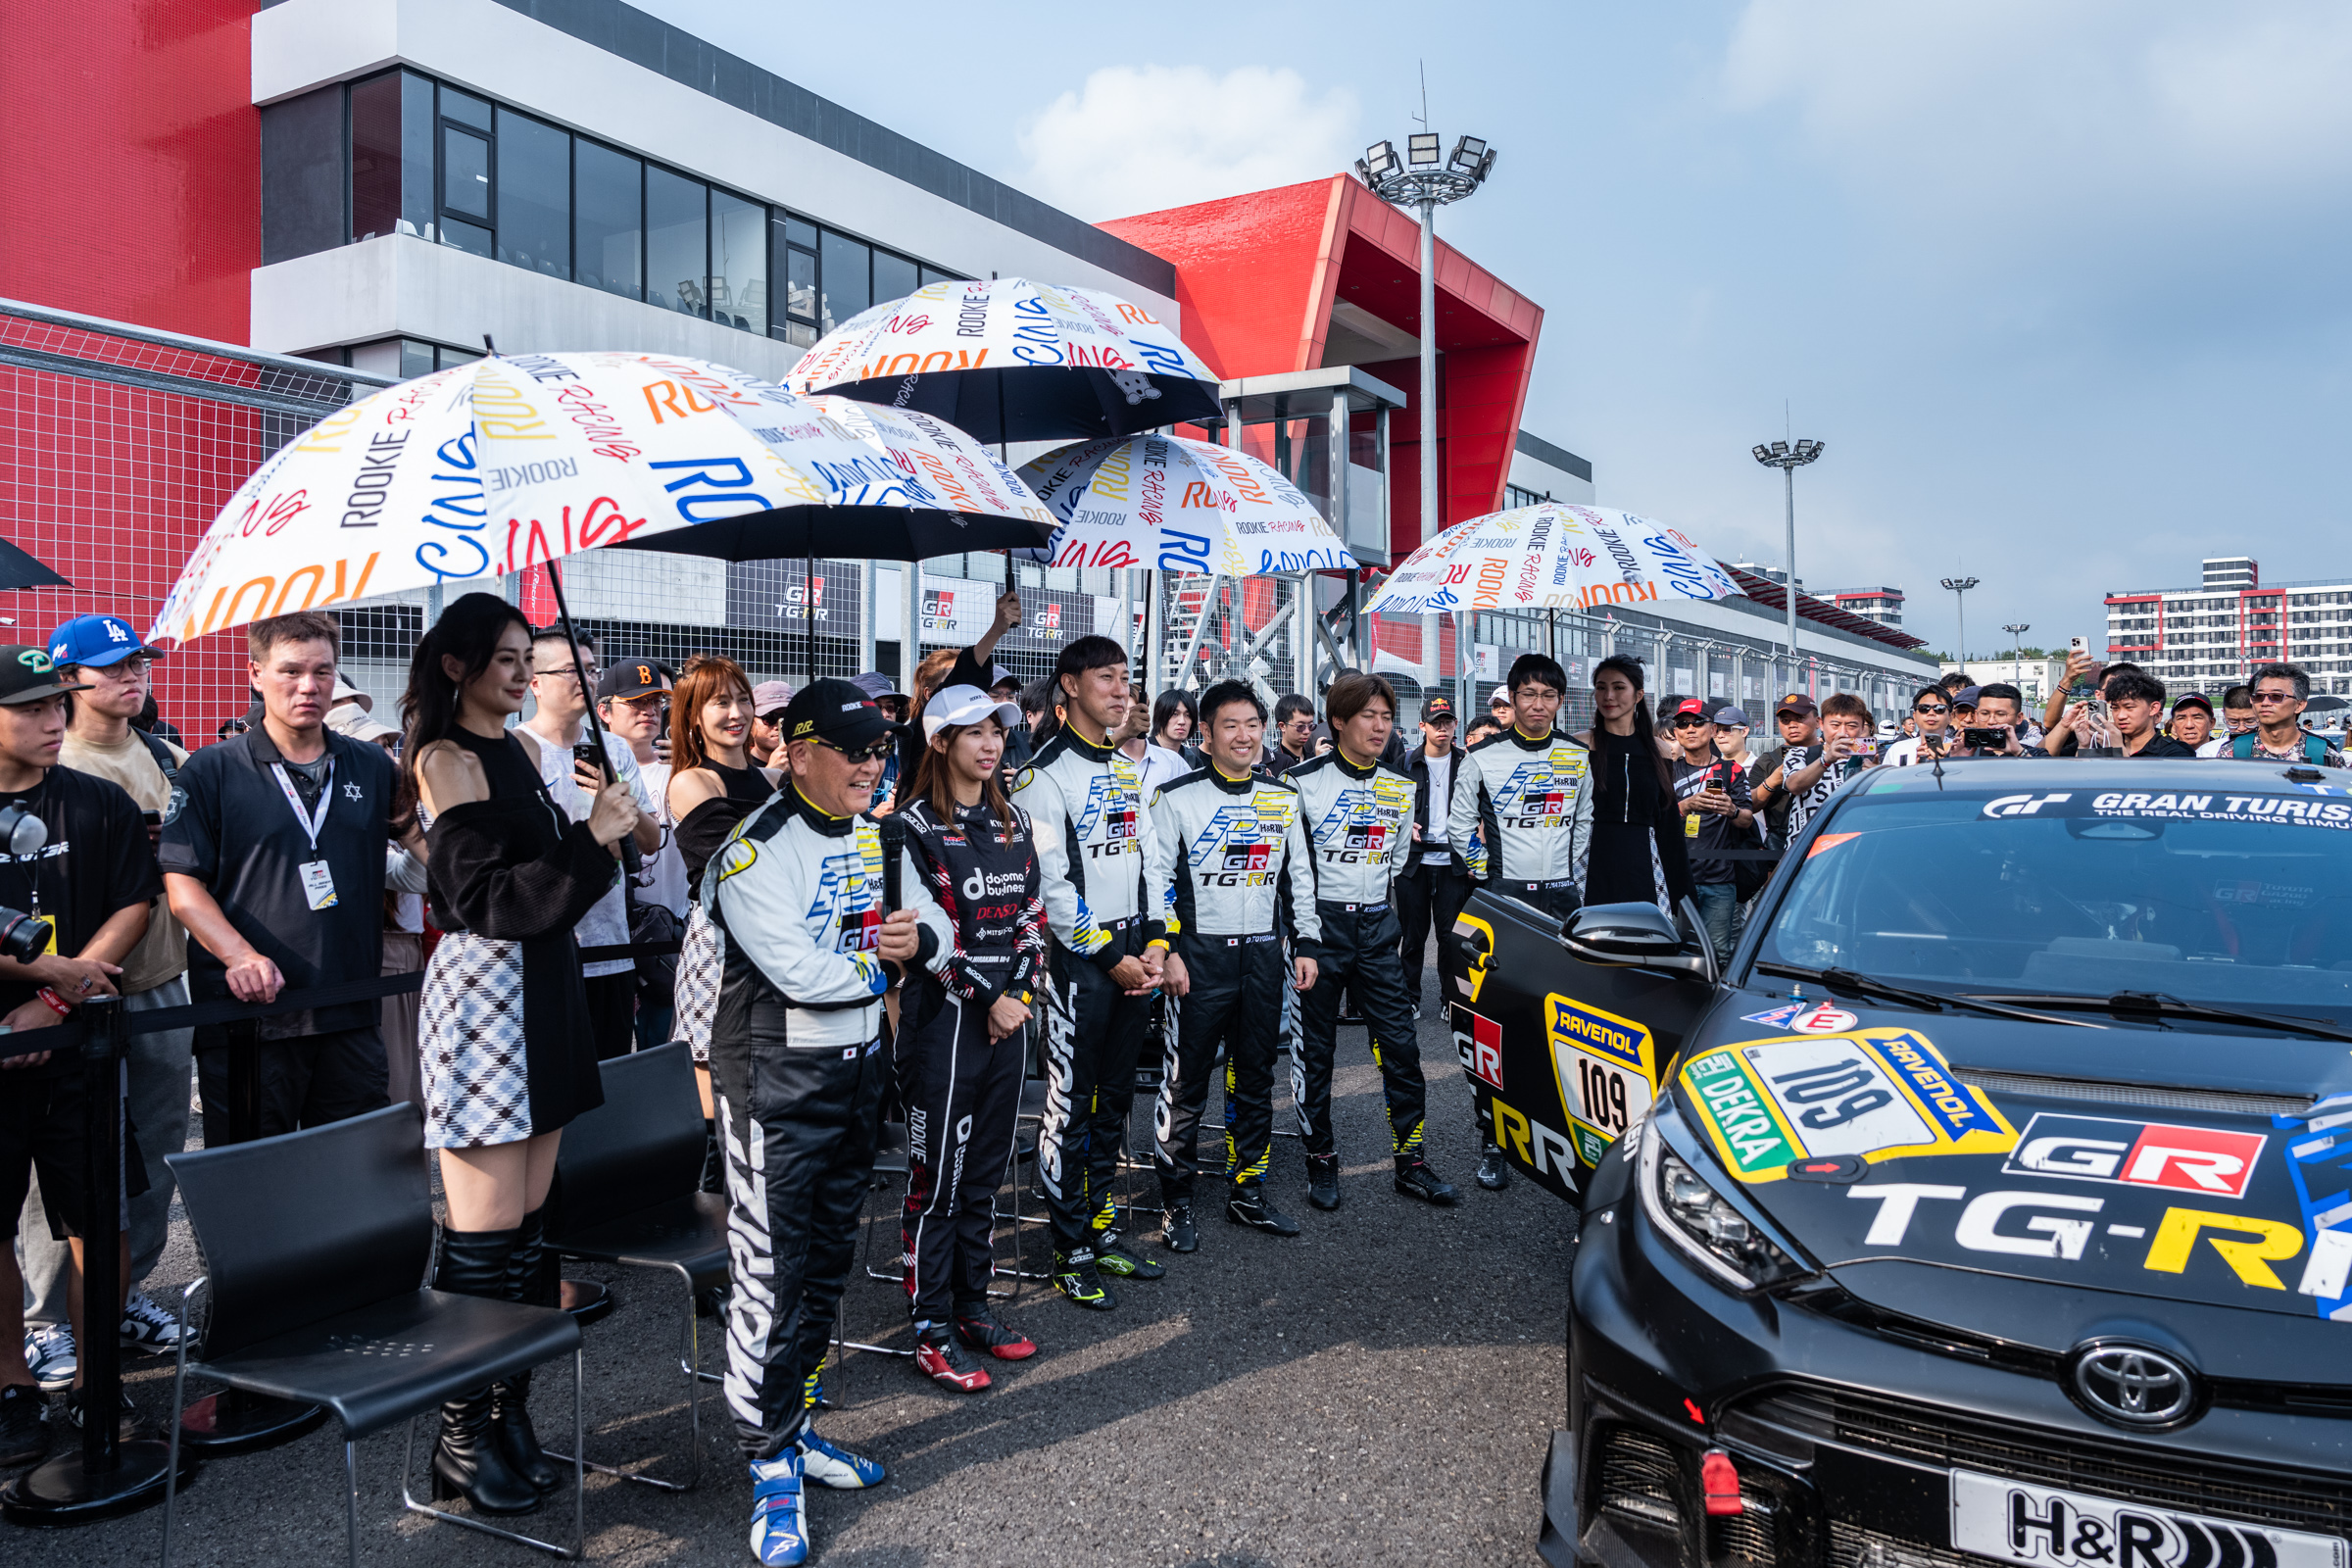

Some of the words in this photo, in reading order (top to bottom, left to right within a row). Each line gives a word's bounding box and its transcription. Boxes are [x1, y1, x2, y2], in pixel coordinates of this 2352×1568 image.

[956, 295, 990, 337] ROOKIE
[1052, 317, 1096, 335] ROOKIE
[547, 383, 642, 464] RACING
[899, 411, 963, 454] ROOKIE
[947, 453, 1010, 513] RACING
[1144, 440, 1169, 468] ROOKIE
[340, 428, 412, 529] ROOKIE
[487, 456, 579, 492] ROOKIE
[1138, 468, 1166, 526] RACING
[1074, 510, 1127, 526] ROOKIE
[1235, 520, 1270, 535] ROOKIE
[1268, 518, 1306, 534] RACING
[1470, 538, 1518, 549] ROOKIE
[1527, 516, 1555, 552] ROOKIE
[1592, 527, 1642, 571] ROOKIE
[1514, 554, 1542, 604] RACING
[785, 586, 821, 605] GR
[922, 599, 953, 616] GR
[1034, 611, 1060, 628] GR
[103, 619, 129, 642] LA
[1028, 627, 1064, 640] TG-RR
[636, 665, 653, 684] B
[841, 702, 862, 712] ROOKIE
[1522, 801, 1562, 814] GR
[2091, 792, 2213, 811] GRAN
[2224, 796, 2352, 821] TURIS
[900, 811, 928, 835] sparco
[1502, 815, 1572, 828] TG-RR
[2140, 809, 2196, 818] REAL
[2199, 811, 2288, 824] DRIVING
[1107, 820, 1136, 839] GR
[1346, 834, 1384, 849] GR
[1223, 854, 1268, 870] GR
[1323, 849, 1391, 864] TG-RR
[1199, 871, 1276, 887] TG-RR
[2263, 882, 2314, 894] TOYOTA
[2215, 887, 2256, 901] GR
[976, 903, 1018, 920] DENSO
[1813, 1013, 1843, 1029] E
[1559, 1010, 1638, 1056] RAVENOL
[1452, 1031, 1500, 1086] GR
[1771, 1058, 1894, 1130] 109
[1884, 1040, 1975, 1129] RAVENOL
[1577, 1056, 1629, 1135] 109
[1701, 1075, 1782, 1166] DEKRA
[910, 1104, 927, 1164] ROOKIE
[2019, 1136, 2245, 1192] GR
